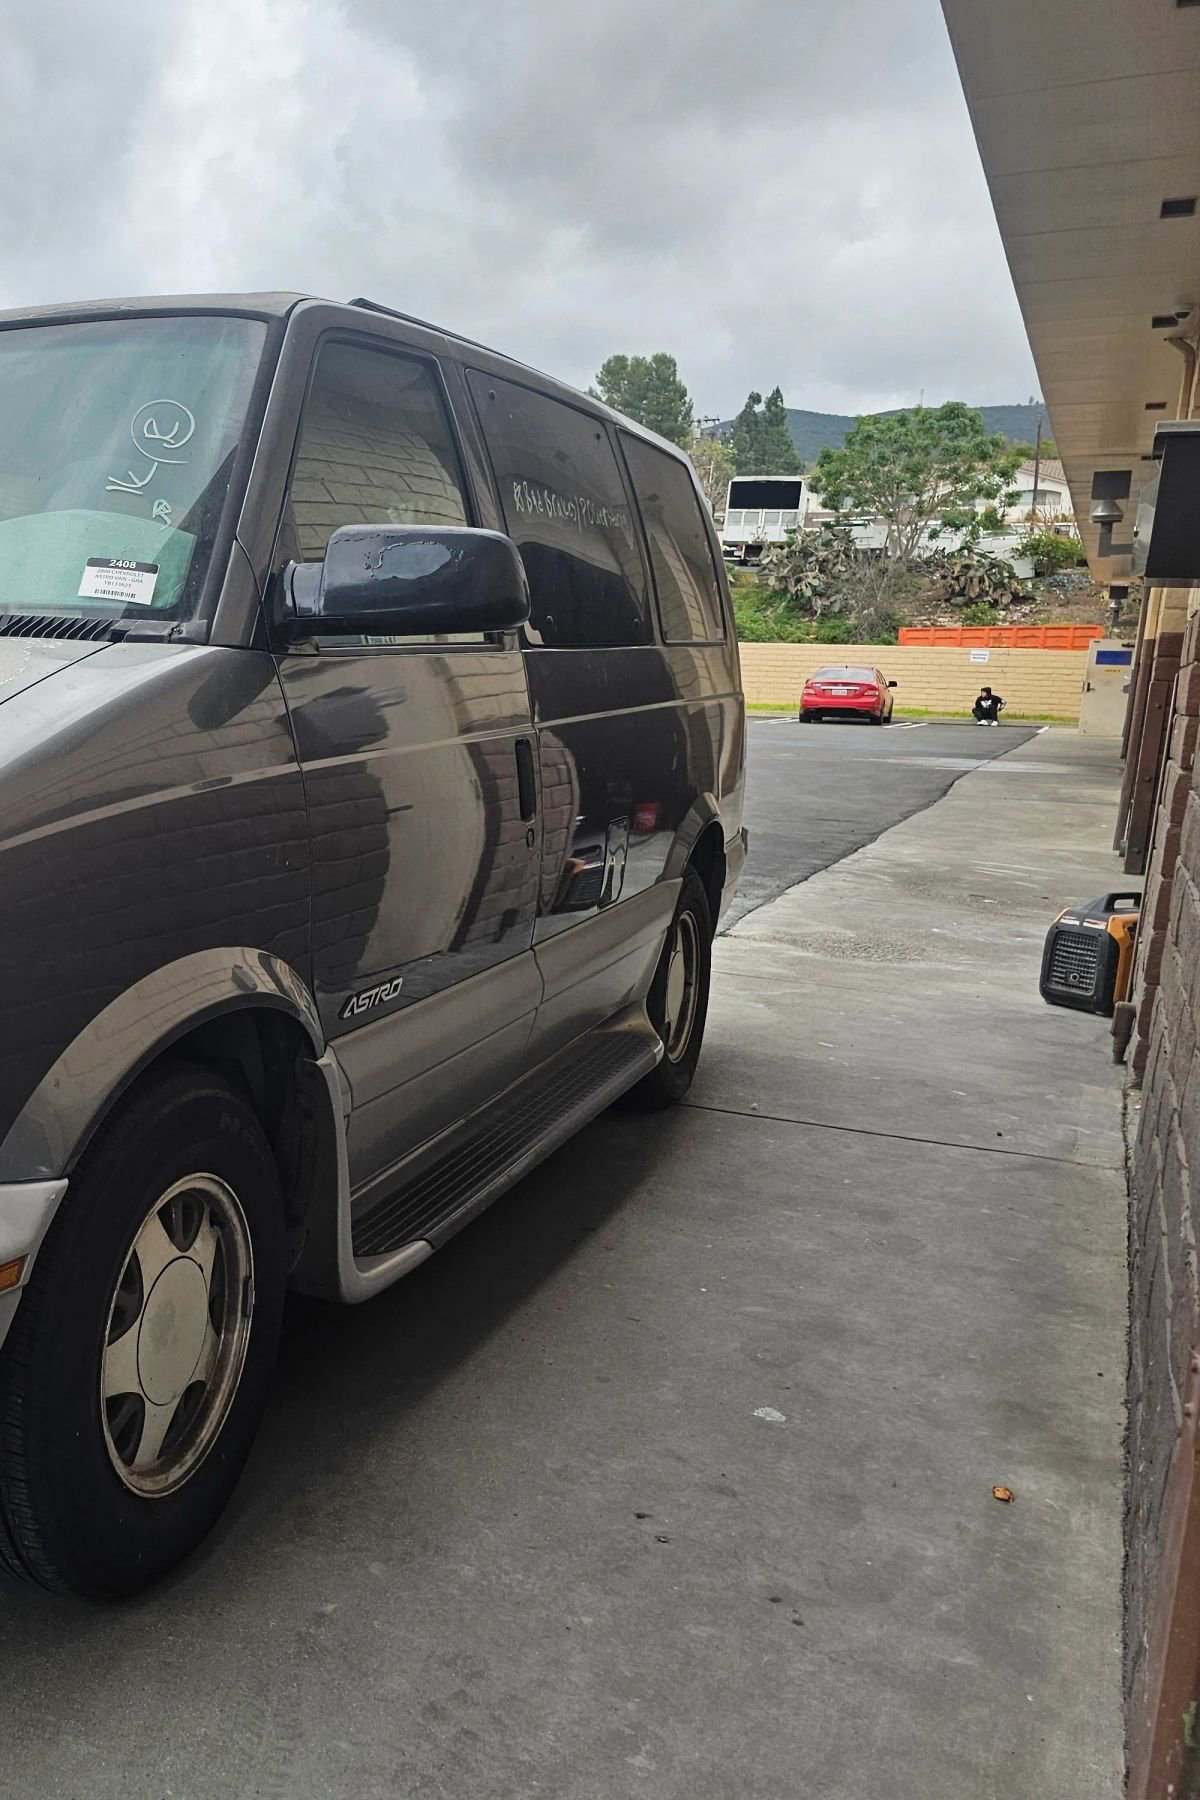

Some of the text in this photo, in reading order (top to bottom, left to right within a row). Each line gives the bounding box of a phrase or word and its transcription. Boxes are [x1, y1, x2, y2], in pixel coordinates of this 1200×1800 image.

[109, 559, 137, 569] 2408
[111, 569, 145, 578] CHEVROLET
[342, 977, 403, 1019] ASTRO
